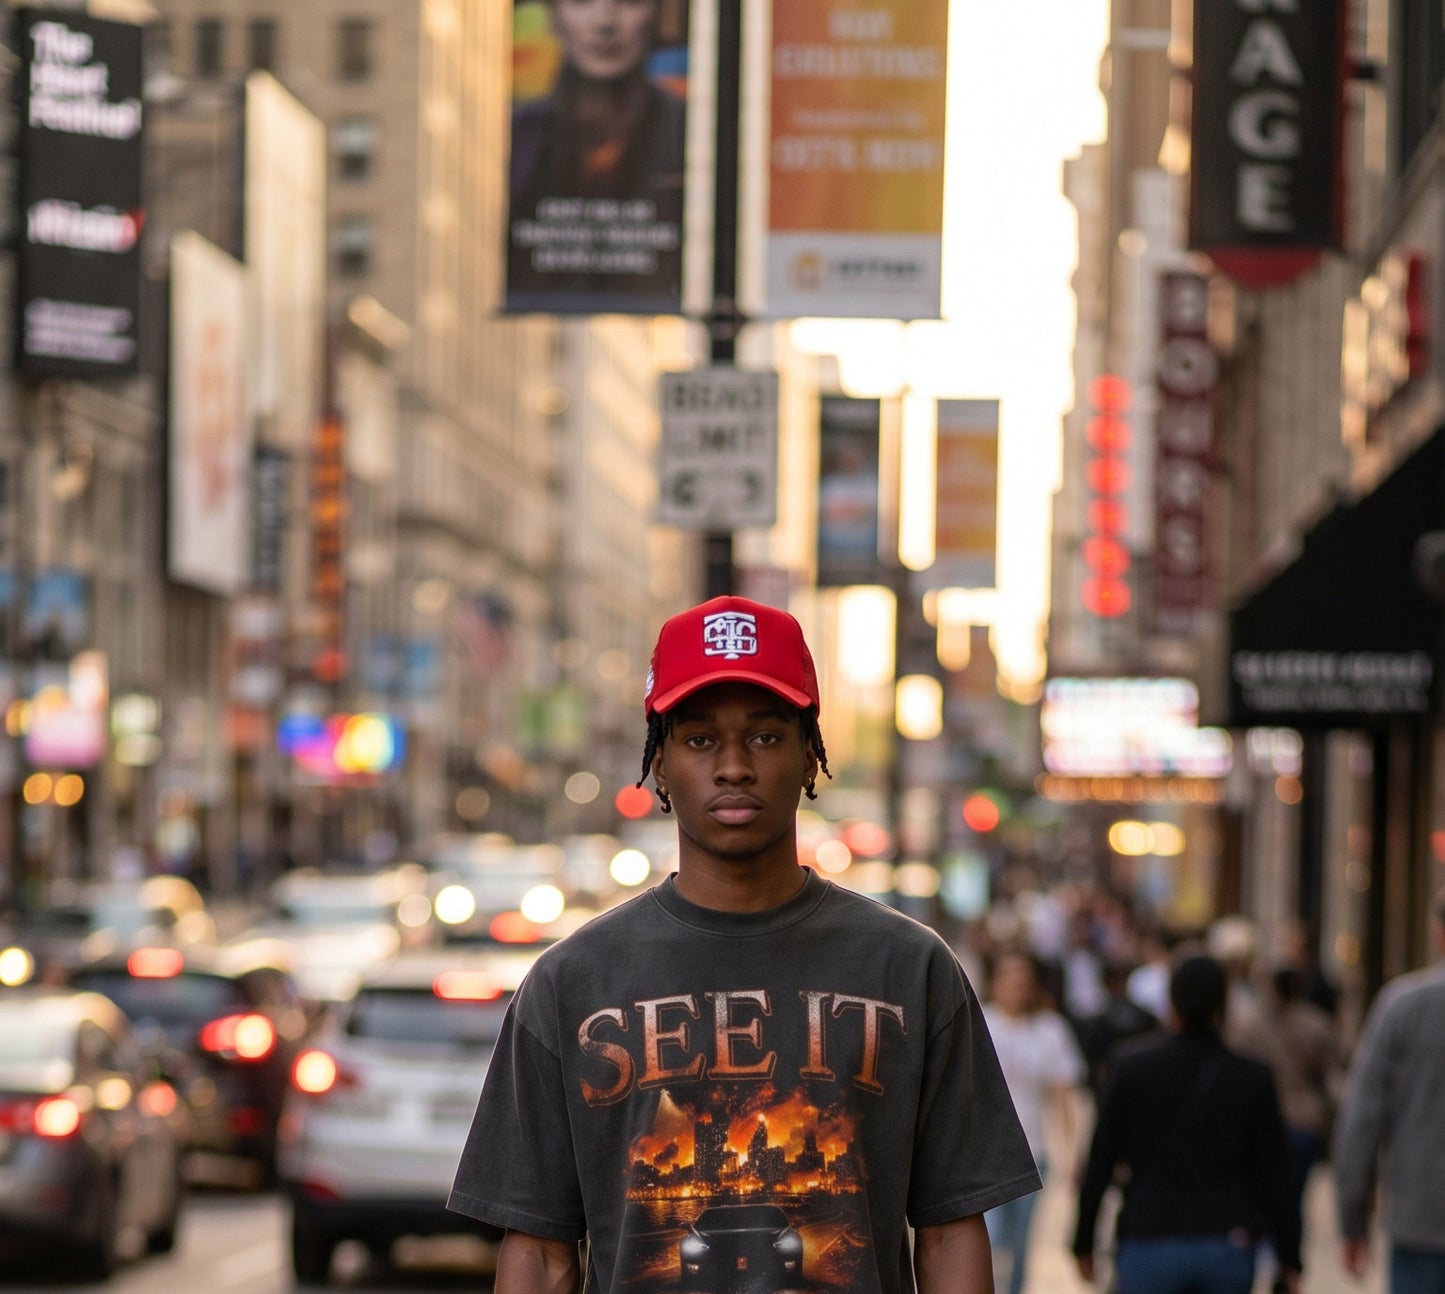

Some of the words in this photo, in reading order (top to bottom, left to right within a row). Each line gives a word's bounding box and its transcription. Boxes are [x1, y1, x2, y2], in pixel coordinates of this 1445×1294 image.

[1227, 0, 1304, 233] AGE
[578, 989, 778, 1108] SEE
[798, 990, 908, 1096] IT
